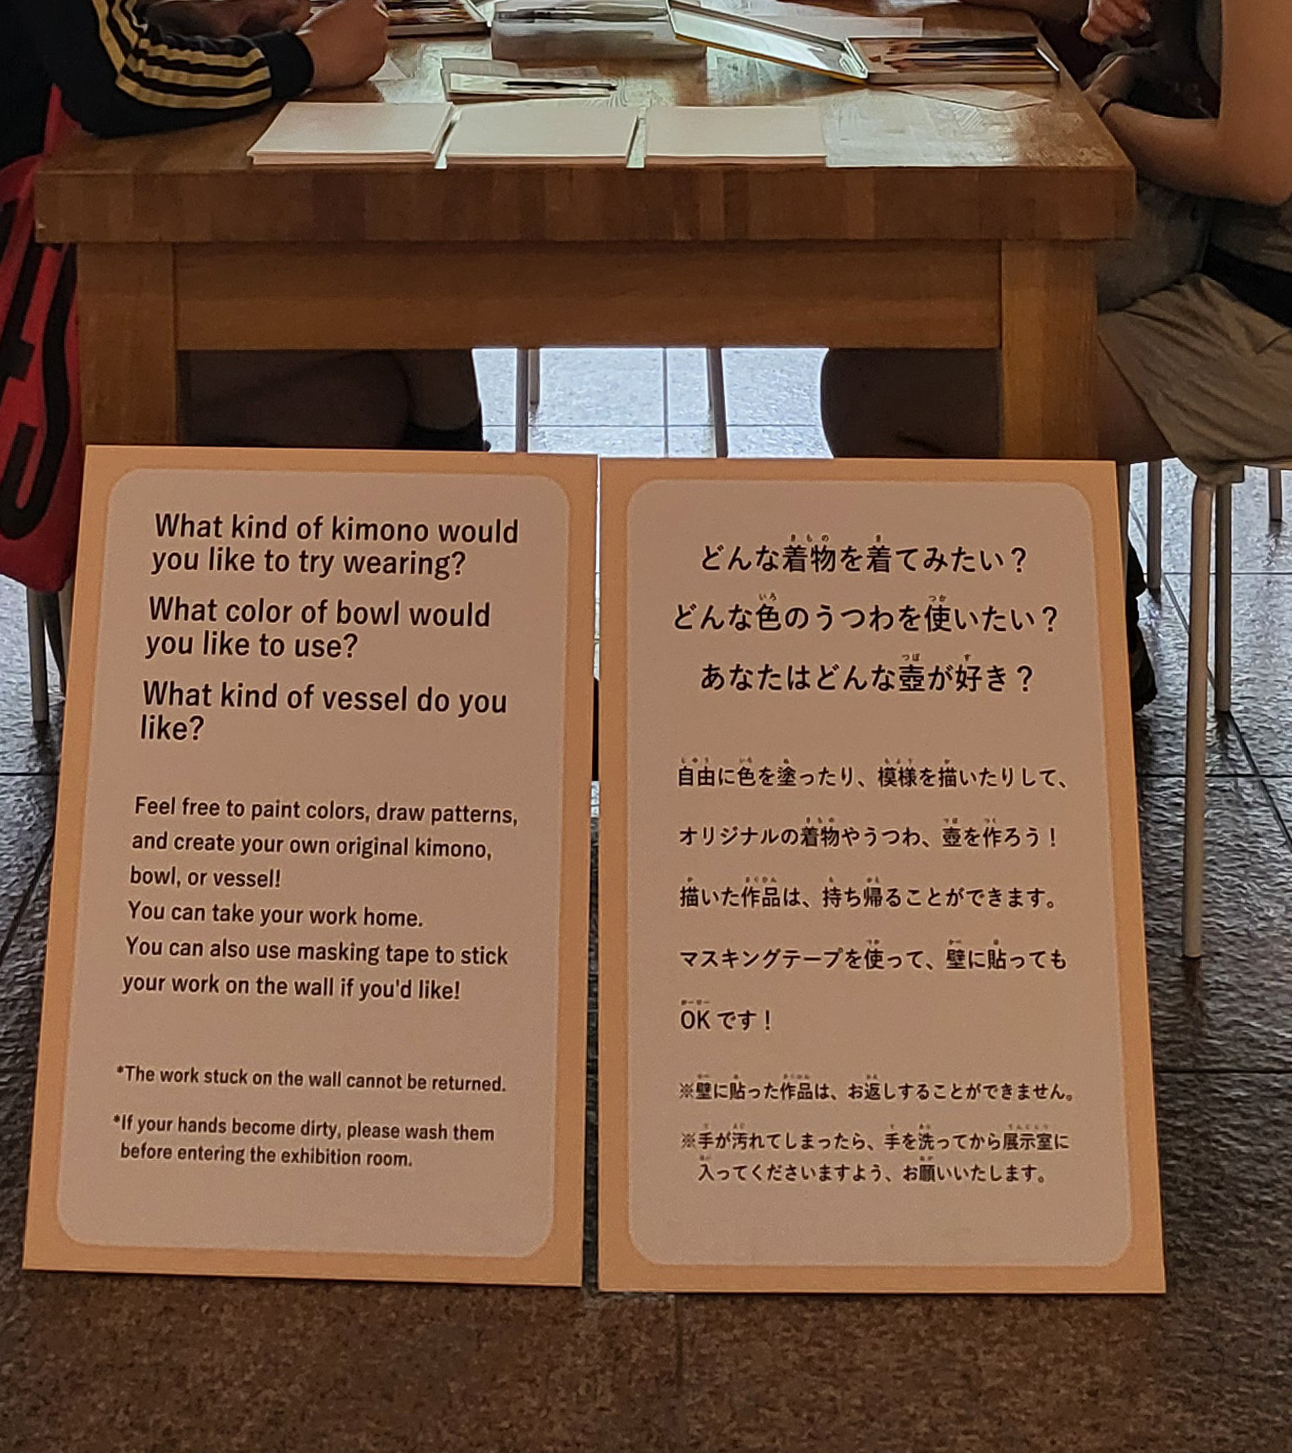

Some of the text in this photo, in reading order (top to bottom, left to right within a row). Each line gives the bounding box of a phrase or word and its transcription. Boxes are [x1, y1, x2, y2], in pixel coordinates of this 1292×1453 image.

[154, 512, 519, 544] What kind of kimono would
[150, 545, 466, 581] you like to try wearing?
[149, 595, 491, 628] What color of bowl would
[144, 629, 359, 660] you like to use?
[142, 679, 507, 719] What kind of vessel do you
[140, 713, 205, 741] like?
[134, 795, 518, 828] Feel free to paint colors, draw patterns,
[131, 830, 492, 862] and create your own original kimono,
[129, 864, 281, 889] bowl, or vessel!
[127, 900, 423, 928] You can take your work home.
[125, 935, 509, 967] You can also use masking tape to stick
[121, 972, 460, 1002] your work on the wall if you'd like!
[680, 1009, 711, 1030] OK
[159, 1066, 200, 1084] work
[203, 1067, 249, 1085] stuck
[252, 1072, 273, 1086] on
[277, 1069, 304, 1087] the
[308, 1070, 342, 1088] wall
[346, 1074, 403, 1090] cannot
[406, 1072, 427, 1091] be
[431, 1075, 507, 1093] returned.
[136, 1118, 174, 1135] your
[177, 1115, 227, 1134] hands
[231, 1117, 296, 1136] become
[300, 1118, 342, 1141] dirty,
[346, 1120, 401, 1141] please
[404, 1122, 448, 1140] wash
[452, 1123, 495, 1142] them
[120, 1141, 413, 1168] before entering the exhibition room.
